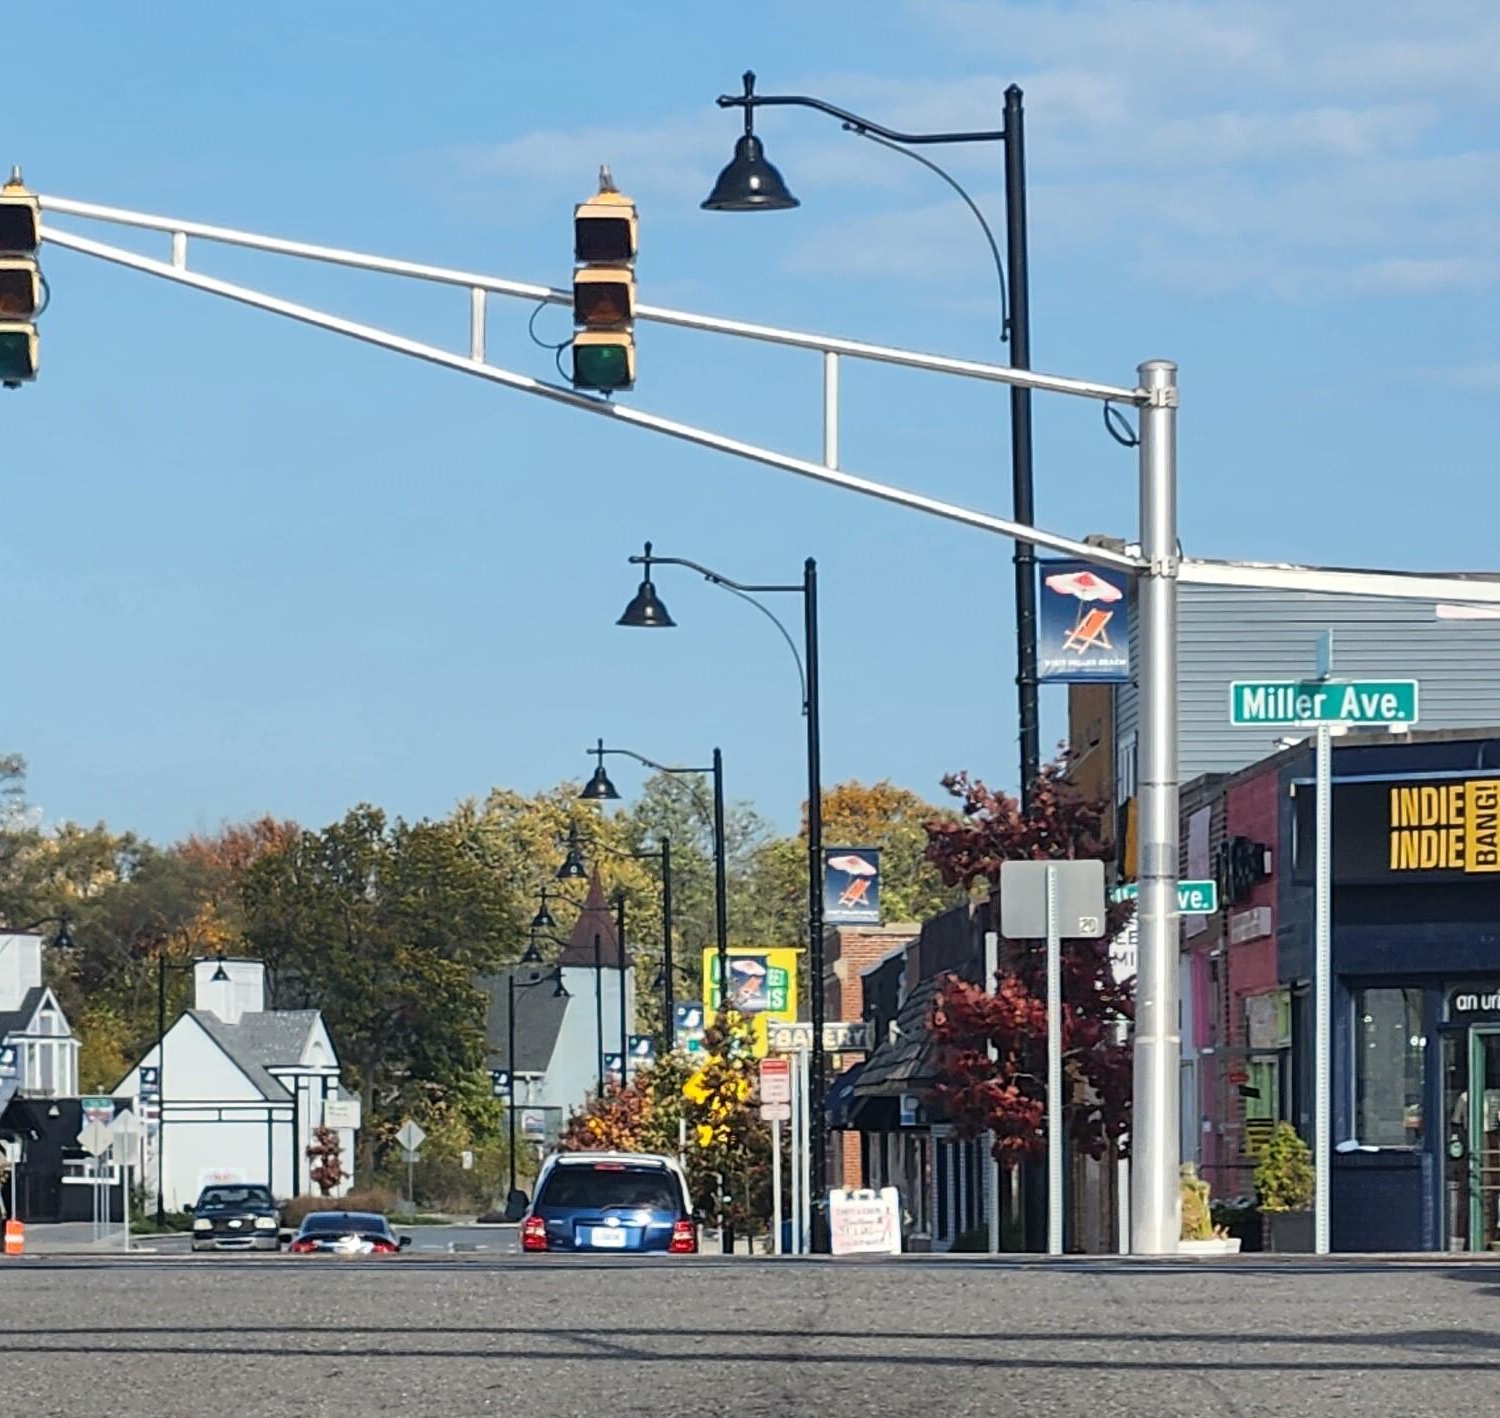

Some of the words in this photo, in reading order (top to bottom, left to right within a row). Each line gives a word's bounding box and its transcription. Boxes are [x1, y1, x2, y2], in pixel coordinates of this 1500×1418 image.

[1243, 687, 1327, 719] Miller
[1340, 686, 1406, 719] Ave.
[1391, 786, 1464, 827] INDIE
[1475, 785, 1498, 866] BANG!
[1390, 829, 1464, 870] INDIE
[1177, 888, 1209, 909] ve.
[1079, 919, 1097, 934] 20
[1456, 995, 1478, 1010] an
[776, 1028, 864, 1048] BAERY
